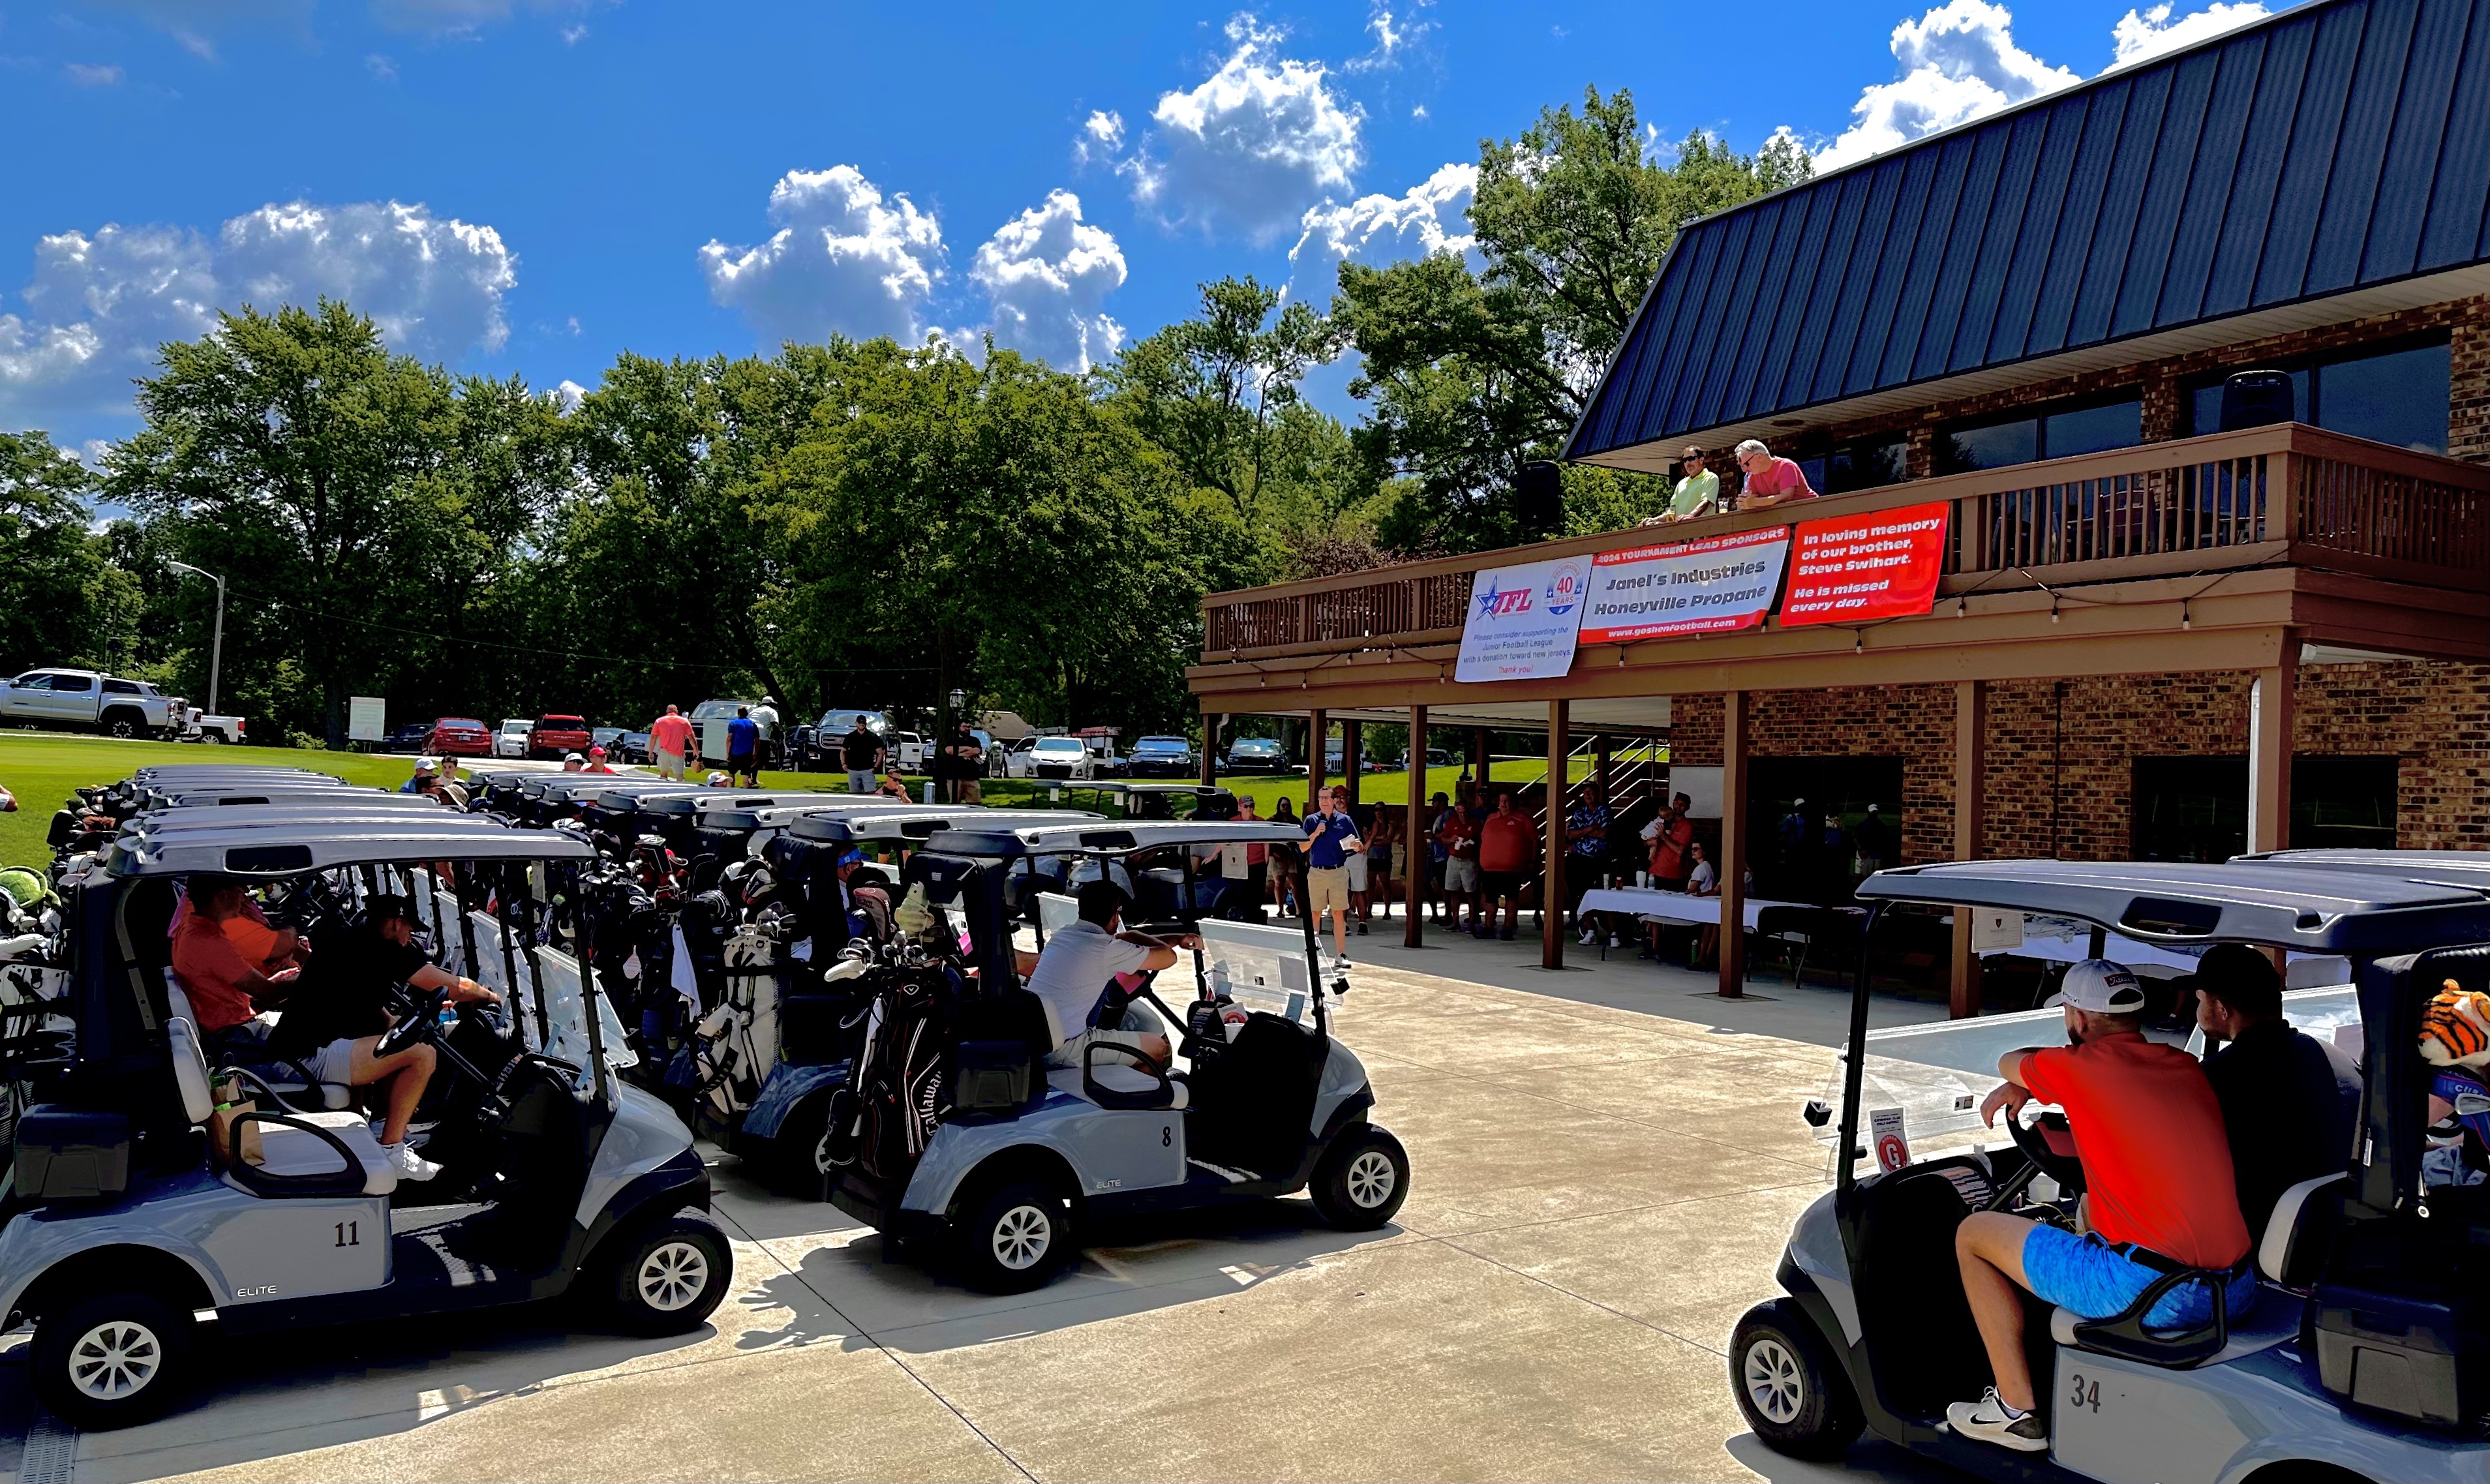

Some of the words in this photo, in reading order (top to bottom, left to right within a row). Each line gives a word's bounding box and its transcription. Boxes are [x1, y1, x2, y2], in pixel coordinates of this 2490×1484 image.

[1804, 535, 1818, 545] In
[1821, 529, 1867, 543] loving
[1871, 519, 1941, 536] memory
[1598, 553, 1620, 563] 2024
[1622, 544, 1688, 559] TOURNAMENT
[1690, 541, 1720, 551] LEAD
[1722, 528, 1785, 547] SPONSORS
[1801, 549, 1817, 560] of
[1820, 547, 1846, 558] our
[1849, 538, 1913, 555] brother,
[1553, 564, 1580, 579] CELEBRATING
[1799, 561, 1843, 575] Steve
[1845, 554, 1911, 571] Swihart.
[1606, 573, 1667, 590] Janel's
[1671, 560, 1765, 584] Industries
[1556, 576, 1573, 594] 40
[1794, 588, 1814, 598] He
[1817, 586, 1830, 596] is
[1832, 579, 1889, 595] missed
[1493, 588, 1533, 614] JFL
[1552, 596, 1573, 605] YEARS
[1594, 594, 1687, 615] Honeyville
[1690, 585, 1767, 607] Propane
[1790, 601, 1834, 613] every
[1835, 598, 1868, 609] day.
[1494, 631, 1521, 639] consider
[1522, 628, 1556, 637] supporting
[1608, 619, 1736, 638] www.goshenfootball.com
[1482, 643, 1500, 651] Junior
[1502, 639, 1528, 649] Football
[1530, 639, 1553, 648] League
[1482, 653, 1508, 662] donation
[1510, 650, 1531, 659] toward
[1498, 665, 1517, 674] Thank
[1518, 665, 1534, 674] you!
[1162, 1126, 1172, 1147] 8
[1096, 1179, 1121, 1189] ELITE
[335, 1220, 359, 1248] 11
[237, 1284, 277, 1297] ELITE
[2071, 1374, 2101, 1414] 34
